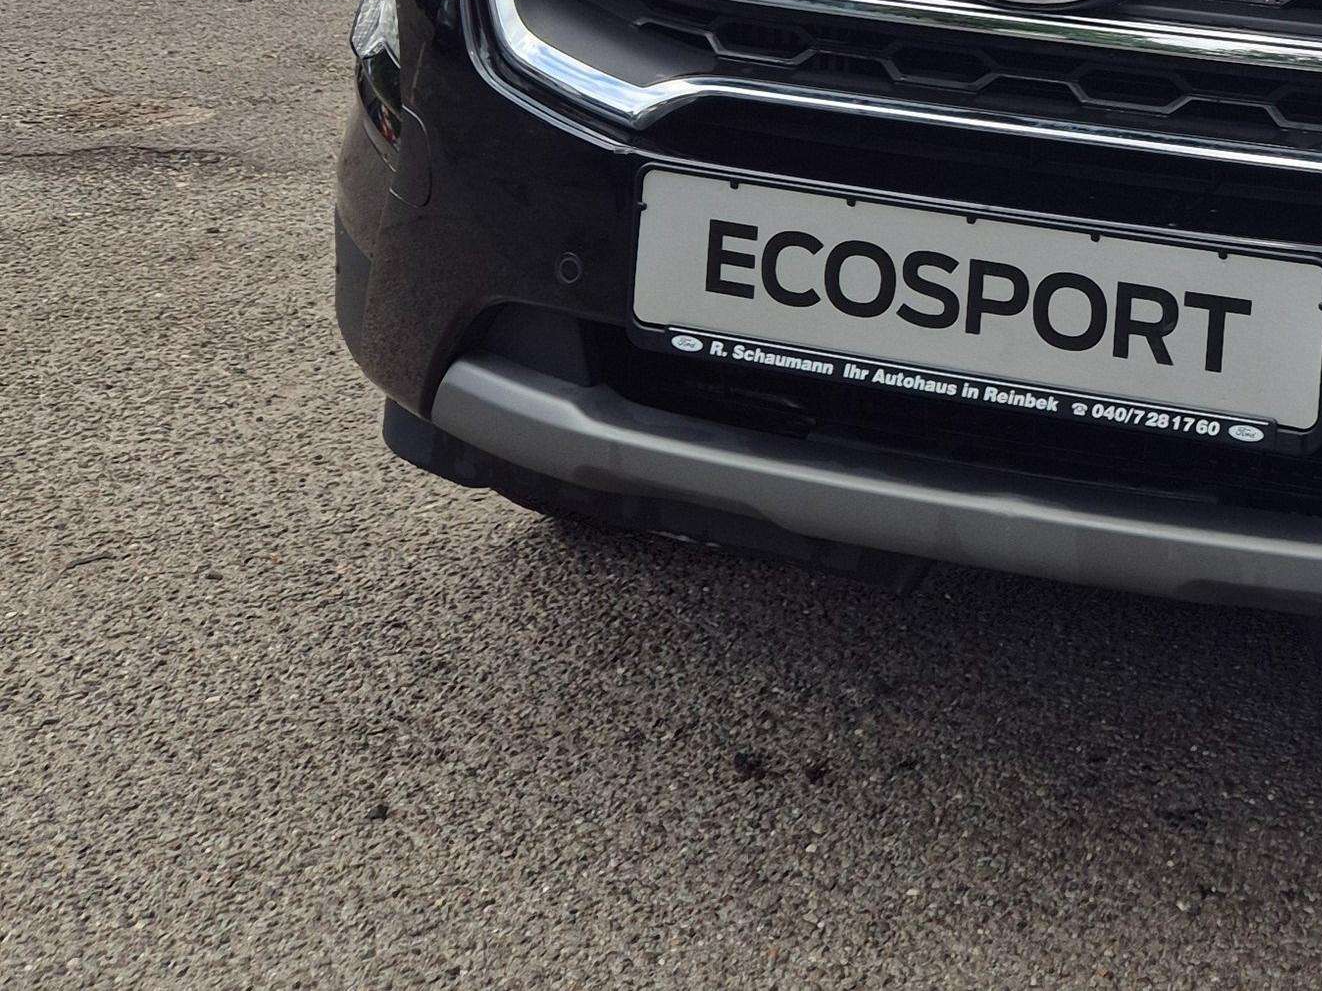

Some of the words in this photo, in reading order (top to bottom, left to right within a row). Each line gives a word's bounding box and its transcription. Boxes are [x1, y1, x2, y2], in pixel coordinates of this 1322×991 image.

[705, 218, 1252, 373] ECOSPORT
[710, 340, 728, 357] R.
[732, 344, 834, 375] Schaumann
[842, 363, 870, 381] Ihr
[871, 368, 958, 396] Autohaus
[961, 382, 980, 400] in
[983, 386, 1059, 412] Reinbek
